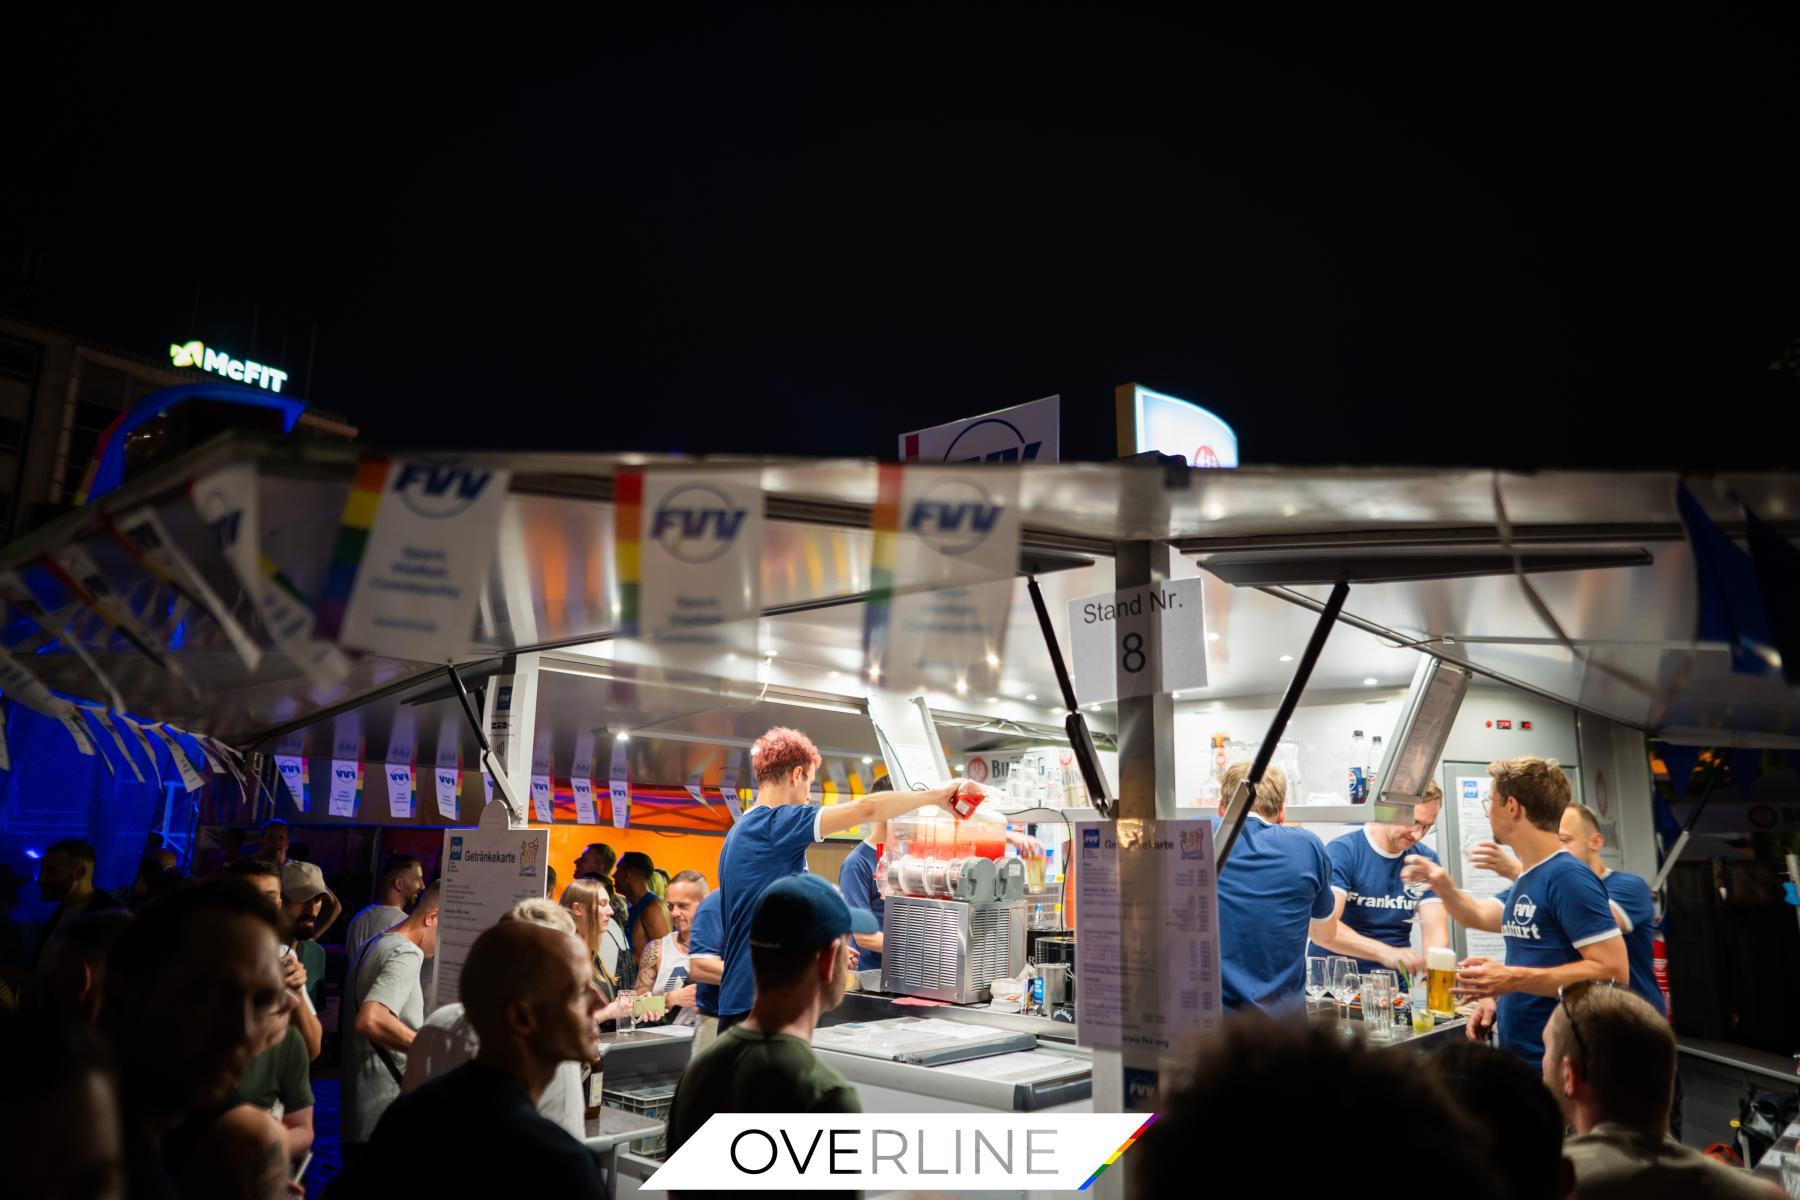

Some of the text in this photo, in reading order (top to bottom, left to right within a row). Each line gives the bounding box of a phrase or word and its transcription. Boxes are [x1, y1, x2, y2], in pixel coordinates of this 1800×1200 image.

[203, 346, 288, 393] McFIT
[391, 462, 491, 499] FVV
[650, 508, 748, 541] FVV
[905, 499, 1004, 535] FVV
[1083, 588, 1183, 625] Stand Nr.
[1122, 632, 1146, 674] 8
[464, 849, 516, 863] Getränkekarte
[1346, 891, 1417, 910] Frankfur
[1513, 903, 1537, 918] FVV
